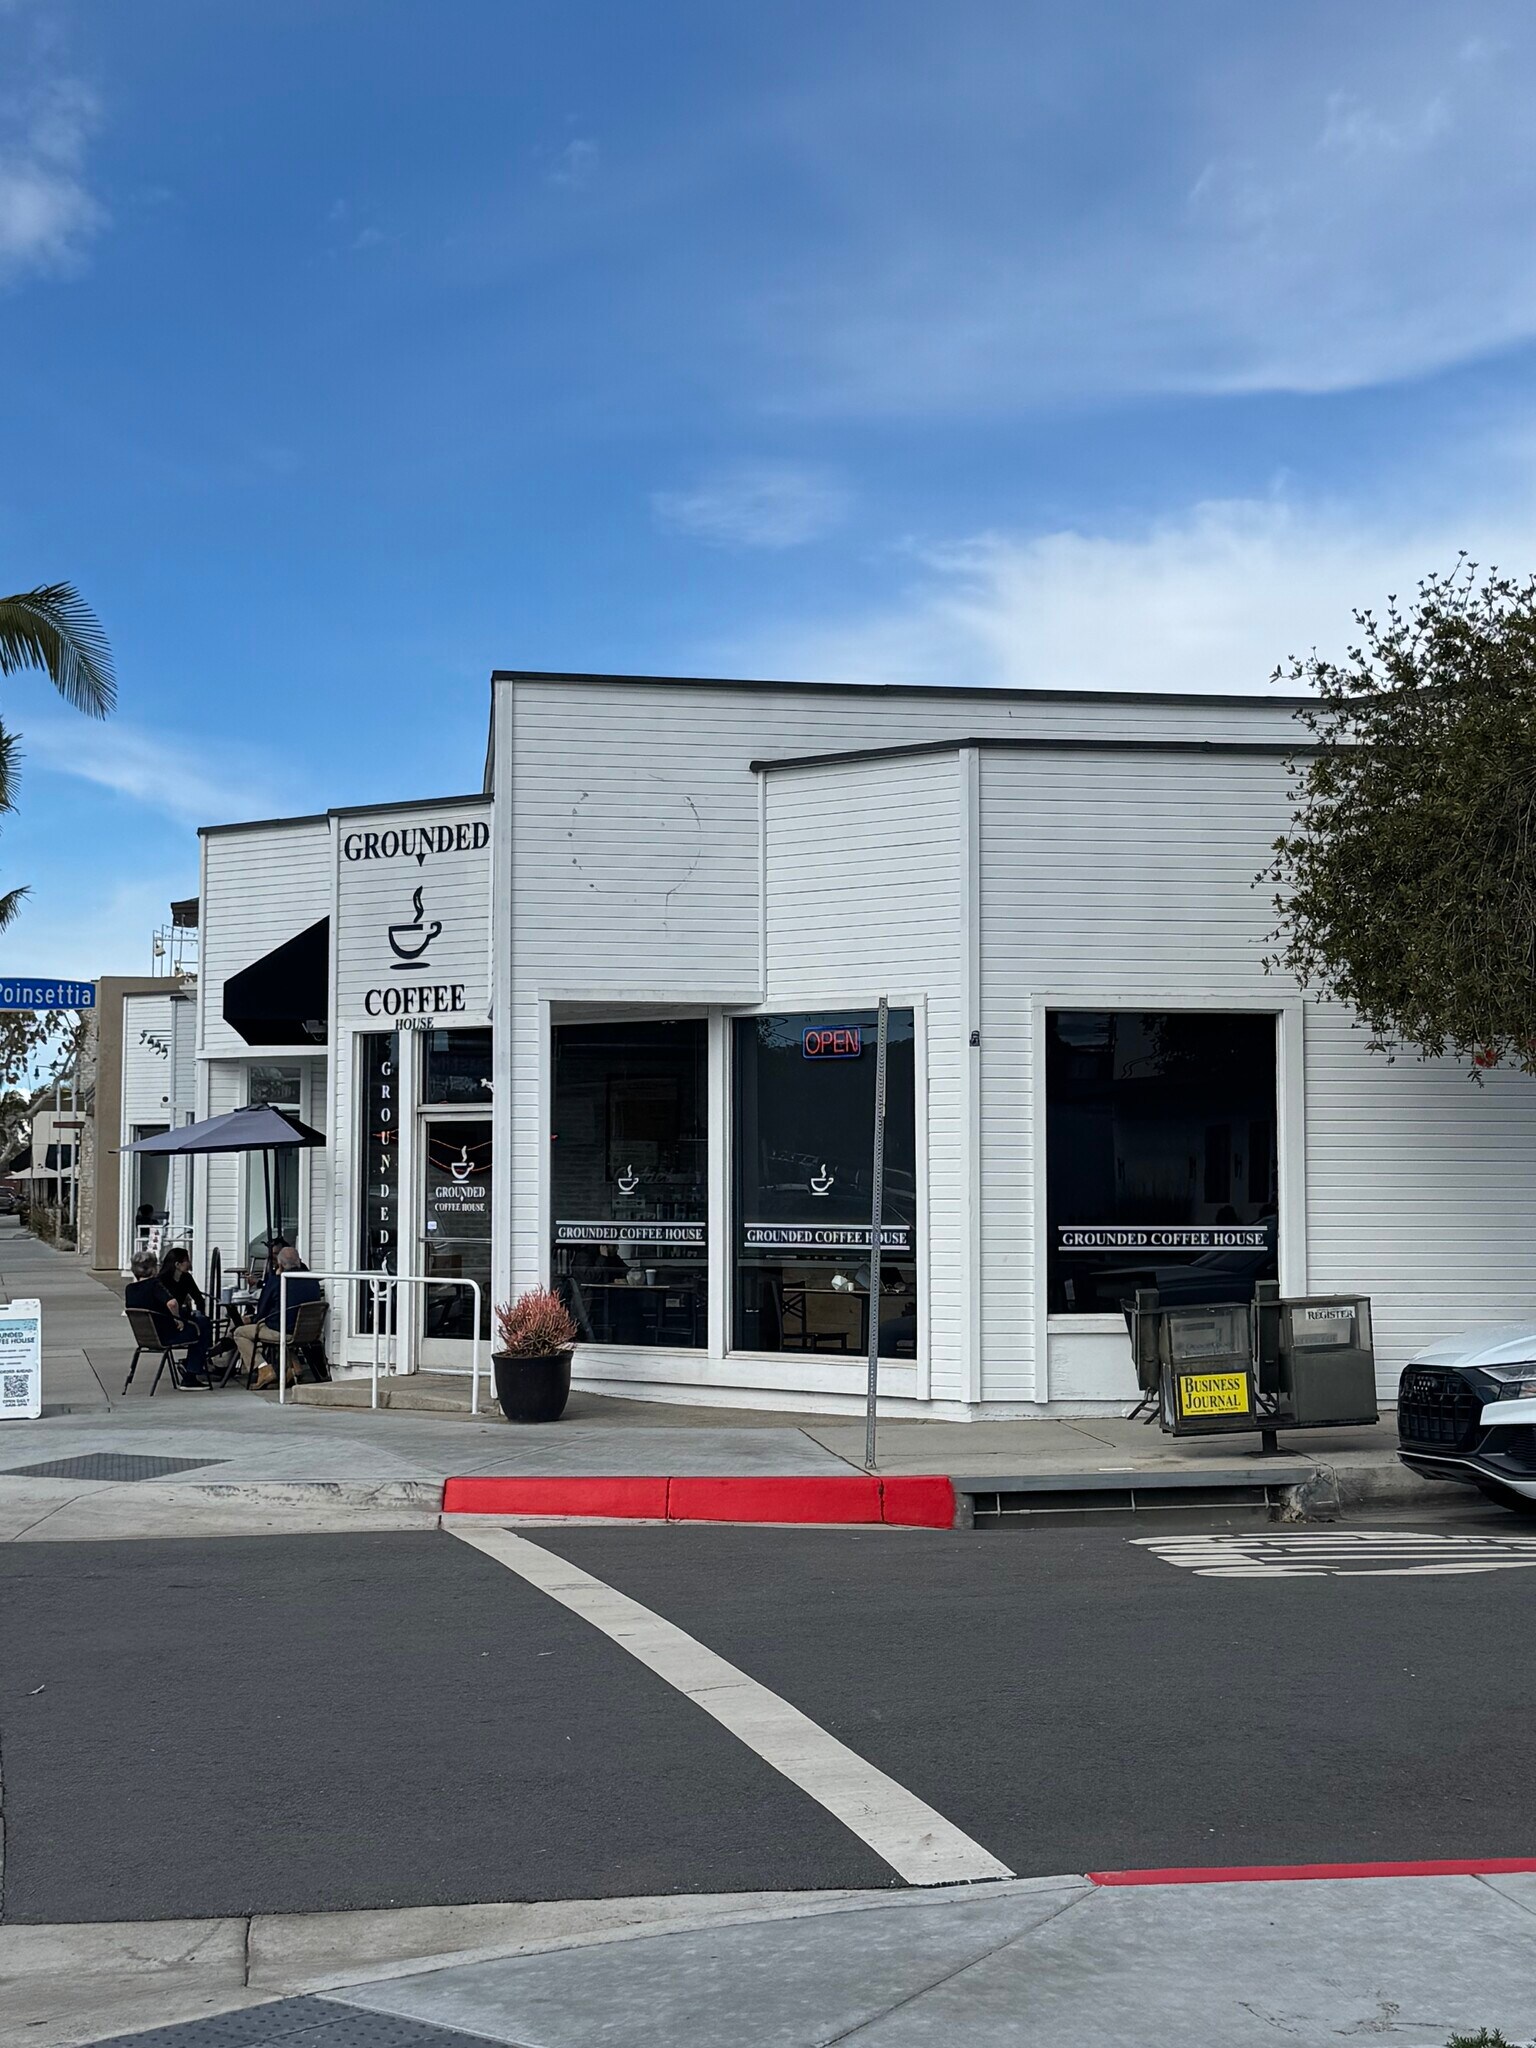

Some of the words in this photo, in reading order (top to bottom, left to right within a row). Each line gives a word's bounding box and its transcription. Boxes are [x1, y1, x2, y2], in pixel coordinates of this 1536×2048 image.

[344, 822, 490, 862] GROUNDED
[365, 984, 466, 1016] COFFEE
[395, 1017, 434, 1031] HOUSE
[805, 1029, 858, 1054] OPEN
[379, 1061, 392, 1245] GROUNDED
[435, 1186, 486, 1199] GROUNDED
[434, 1203, 461, 1212] COFFEE
[462, 1203, 485, 1212] HOUSE
[558, 1226, 618, 1239] GROUNDED
[620, 1228, 663, 1240] COFFEE
[665, 1228, 703, 1240] HOUSE
[747, 1229, 813, 1243] GROUNDED
[815, 1231, 863, 1243] COFFEE
[1062, 1232, 1148, 1245] GROUNDED
[1150, 1232, 1211, 1245] COFFEE
[1213, 1232, 1264, 1245] HOUSE
[1307, 1310, 1354, 1320] REGISTER
[1184, 1377, 1240, 1393] BUSINESS
[1185, 1393, 1241, 1409] JOURNAL
